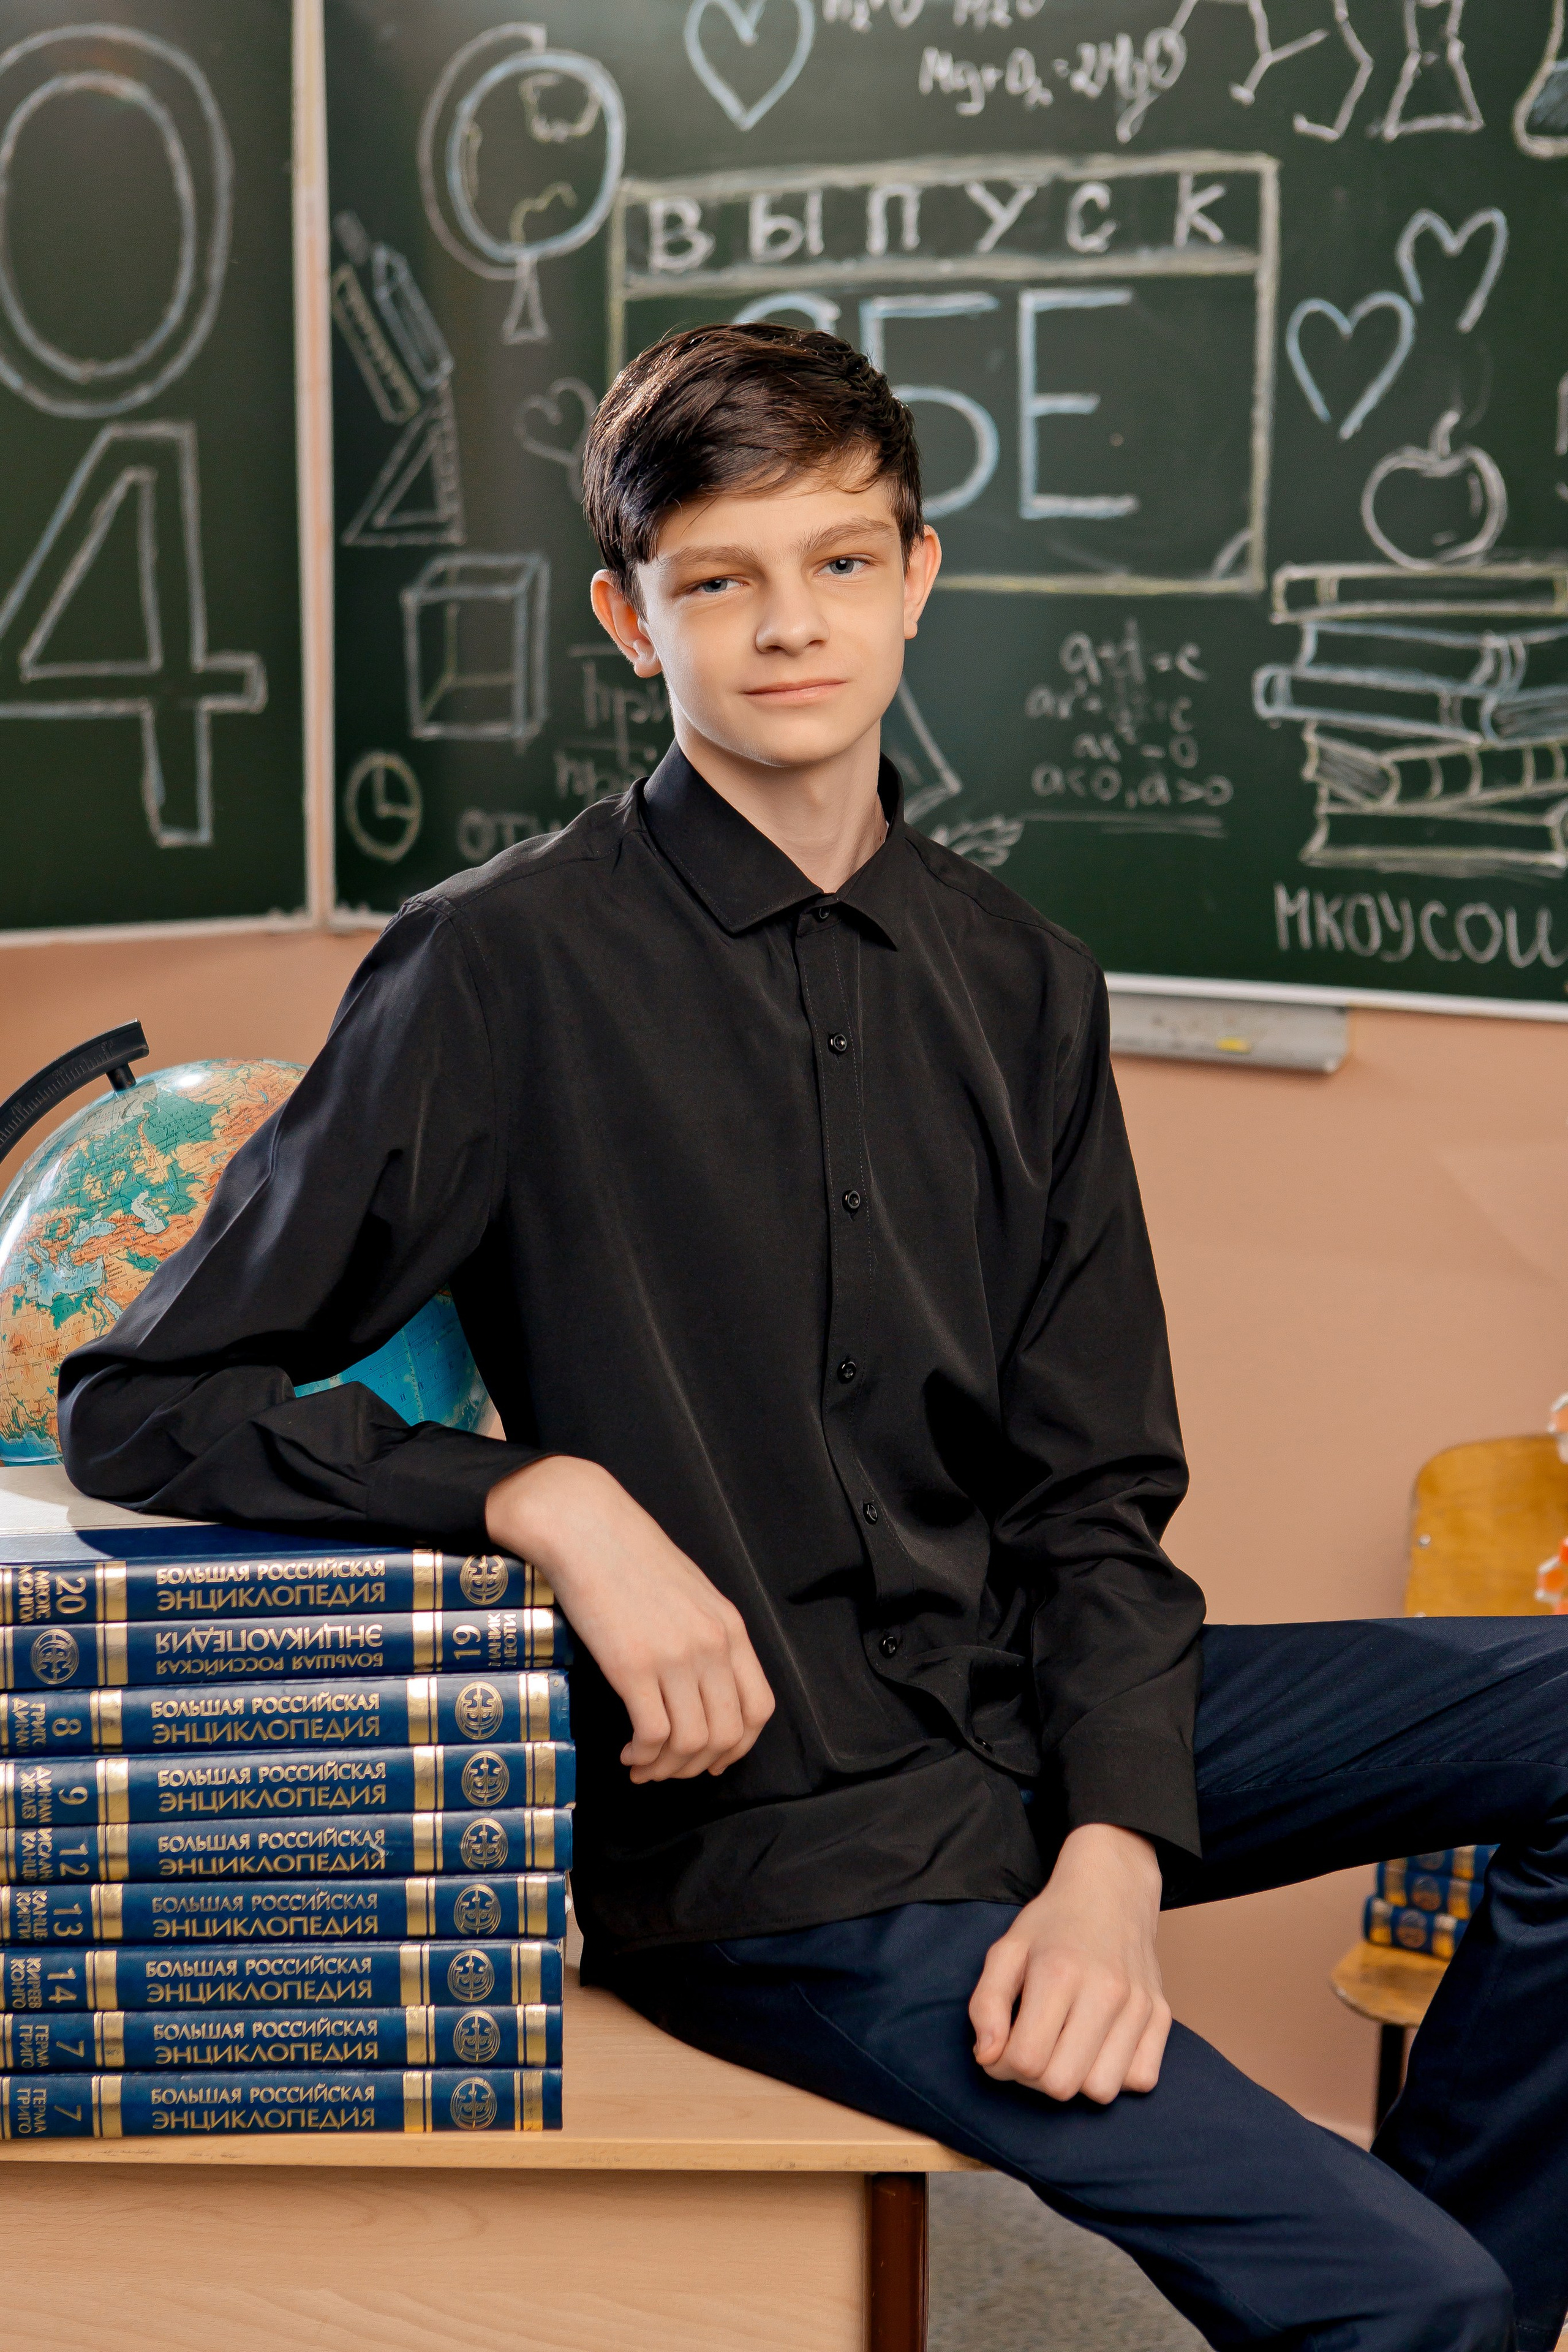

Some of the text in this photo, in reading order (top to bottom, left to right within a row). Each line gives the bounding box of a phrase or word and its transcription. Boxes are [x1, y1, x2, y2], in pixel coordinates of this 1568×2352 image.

[156, 1559, 385, 1584] БОЛЬШАЯ РОССИЙСКАЯ
[55, 1575, 87, 1614] 20
[157, 1583, 385, 1611] ЭНЦИКЛОПЕДИЯ
[156, 1623, 383, 1654] ЭНЦИКЛОПЕДИЯ
[452, 1624, 481, 1660] 19
[156, 1654, 383, 1675] БОЛЬШАЯ РОССИЙСКАЯ
[151, 1692, 379, 1717] БОЛЬШАЯ РОССИЙСКАЯ
[52, 1718, 81, 1737] 8
[153, 1716, 380, 1744] ЭНЦИКЛОПЕДИЯ
[158, 1762, 385, 1787] БОЛЬШАЯ РОССИЙСКАЯ
[58, 1786, 88, 1806] 9
[159, 1784, 385, 1812] ЭНЦИКЛОПЕДИЯ
[159, 1827, 385, 1852] БОЛЬШАЯ РОССИЙСКАЯ
[59, 1844, 89, 1876] 12
[159, 1851, 385, 1875] ЭНЦИКЛОПЕДИЯ
[153, 1891, 377, 1912] БОЛЬШАЯ РОССИЙСКАЯ
[53, 1903, 83, 1937] 13
[154, 1916, 379, 1938] ЭНЦИКЛОПЕДИЯ
[146, 1955, 372, 1977] БОЛЬШАЯ РОССИЙСКАЯ
[10, 1959, 26, 2008] КОНГО
[26, 1958, 42, 2008] КИРЕЕВ
[47, 1967, 77, 2003] 14
[147, 1980, 372, 2005] ЭНЦИКЛОПЕДИЯ
[154, 2018, 377, 2040] БОЛЬШАЯ РОССИЙСКАЯ
[56, 2040, 85, 2057] 7
[155, 2041, 379, 2066] ЭНЦИКЛОПЕДИЯ
[151, 2084, 375, 2104] БОЛЬШАЯ РОССИЙСКАЯ
[54, 2105, 82, 2121] 7
[153, 2108, 375, 2131] ЭНЦИКЛОПЕДИЯ
